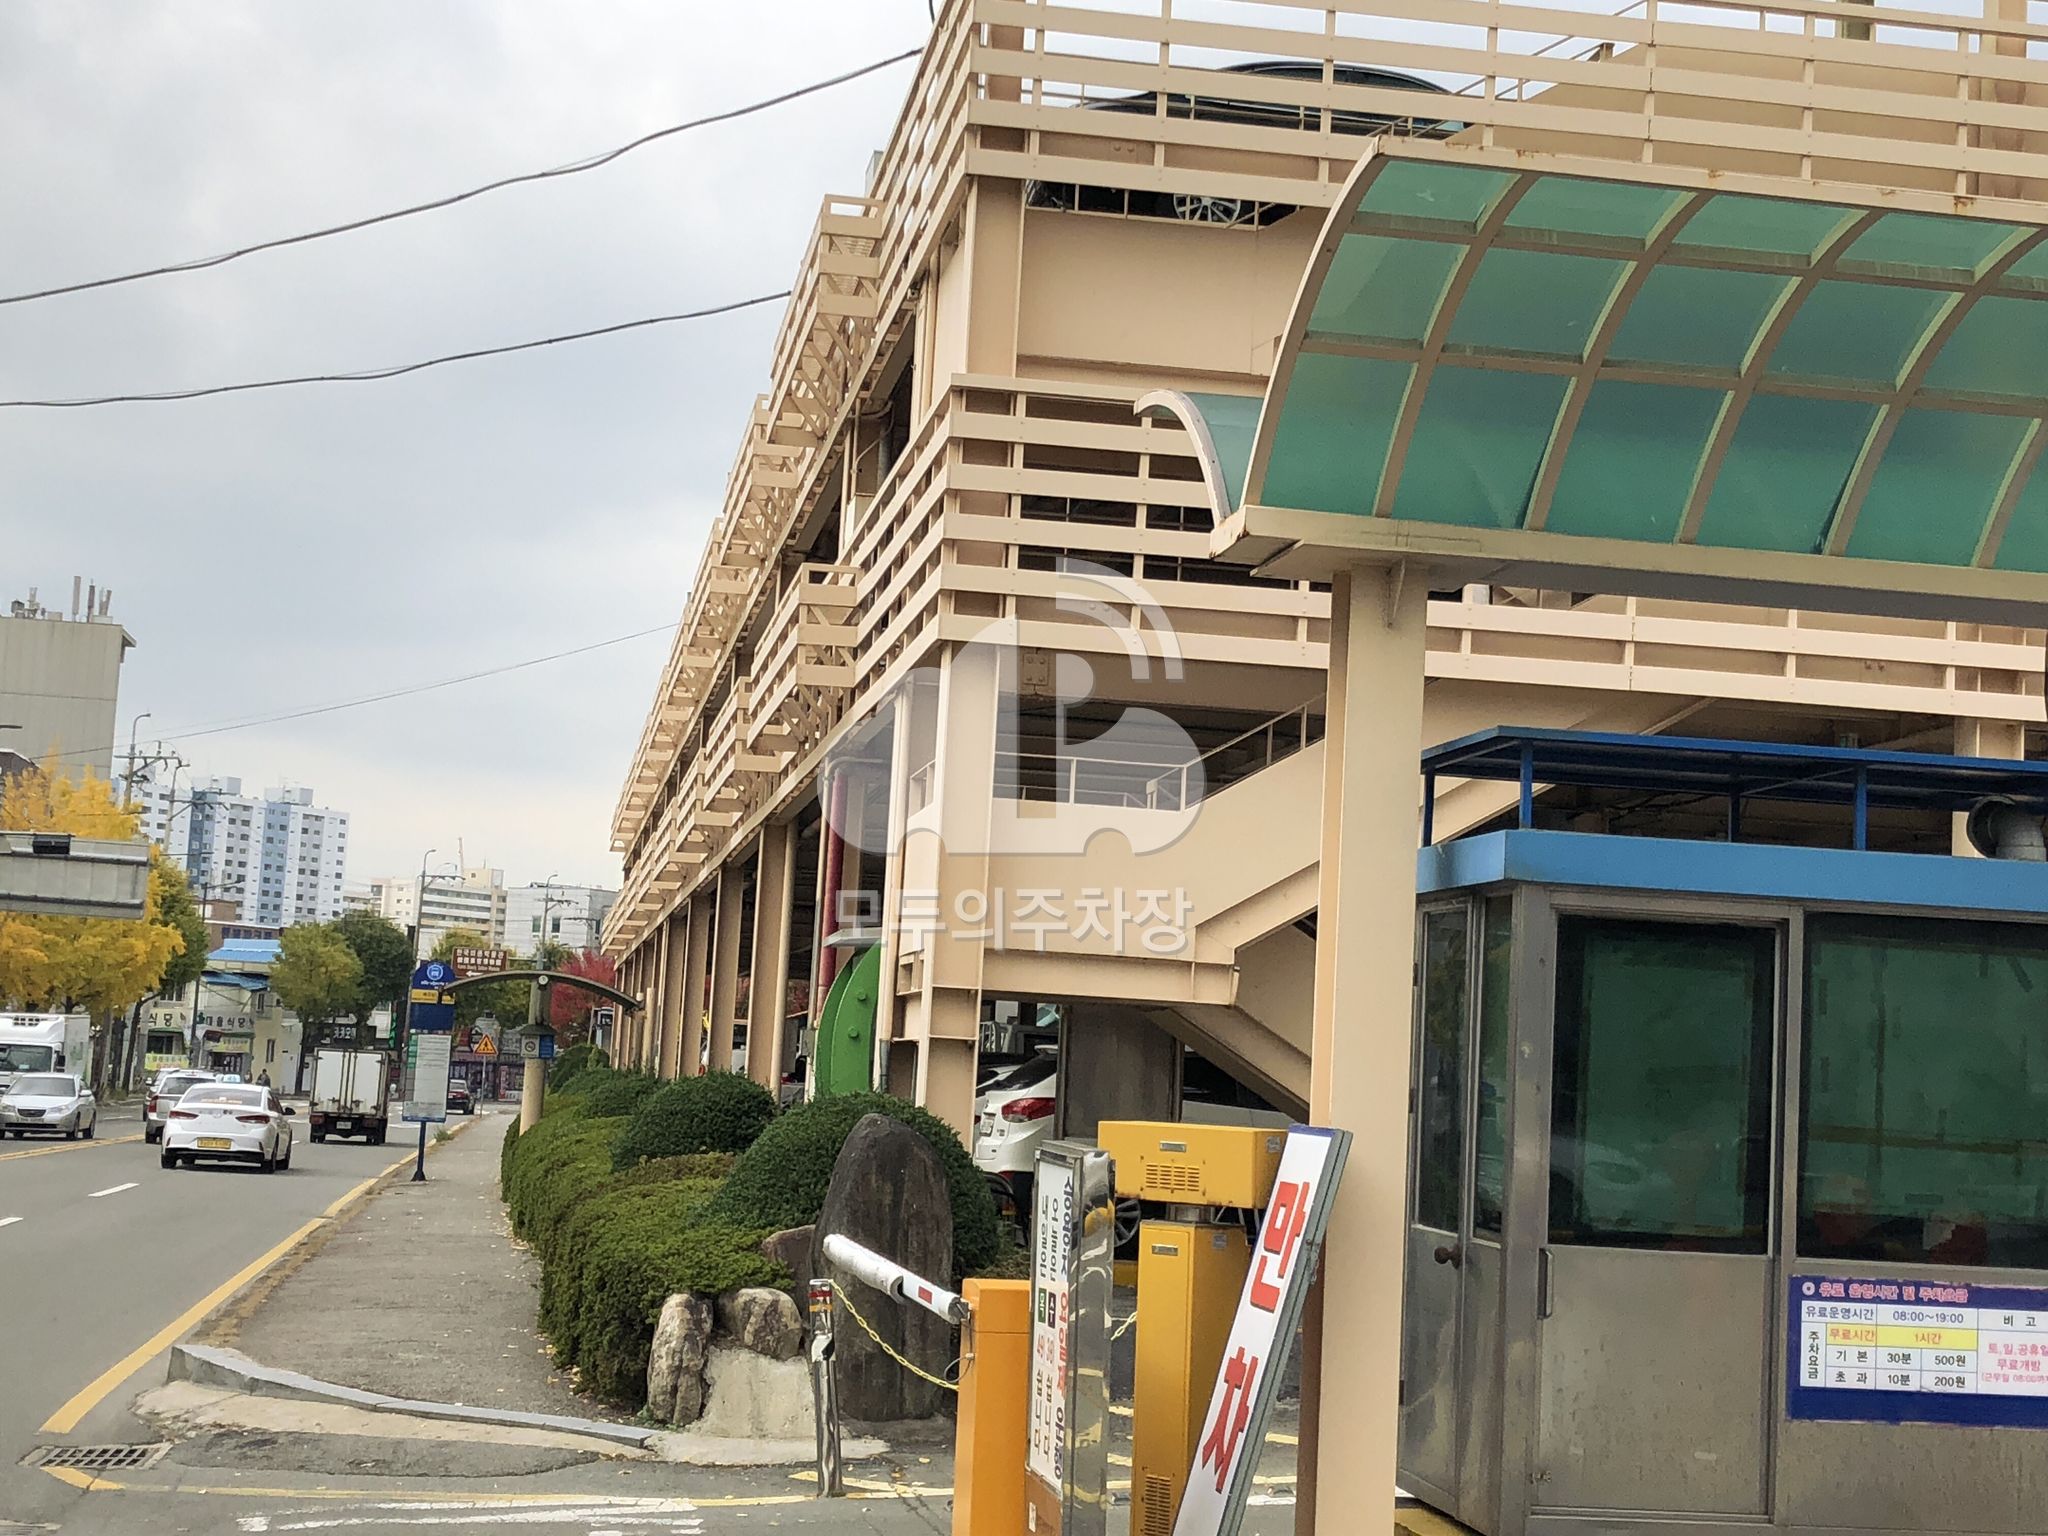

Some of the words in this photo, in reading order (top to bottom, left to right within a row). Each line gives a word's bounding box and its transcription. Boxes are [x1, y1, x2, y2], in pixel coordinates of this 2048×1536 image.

[1819, 1283, 1845, 1297] 유료
[1849, 1284, 1899, 1300] 운영시간
[1903, 1286, 1915, 1300] 및
[1919, 1288, 1968, 1303] 주차요금
[1805, 1306, 1874, 1321] 유료운영시간
[1893, 1310, 1964, 1324] 08:00~19:00
[1202, 1181, 1310, 1494] 만차
[1829, 1328, 1875, 1342] 무료시간
[1915, 1332, 1942, 1345] 1시간
[1808, 1331, 1819, 1379] 주차요금
[1887, 1353, 1912, 1365] 30분
[1934, 1354, 1966, 1367] 500원
[1997, 1358, 2041, 1372] 무료개방
[1888, 1373, 1911, 1385] 10분
[1934, 1376, 1966, 1388] 200원
